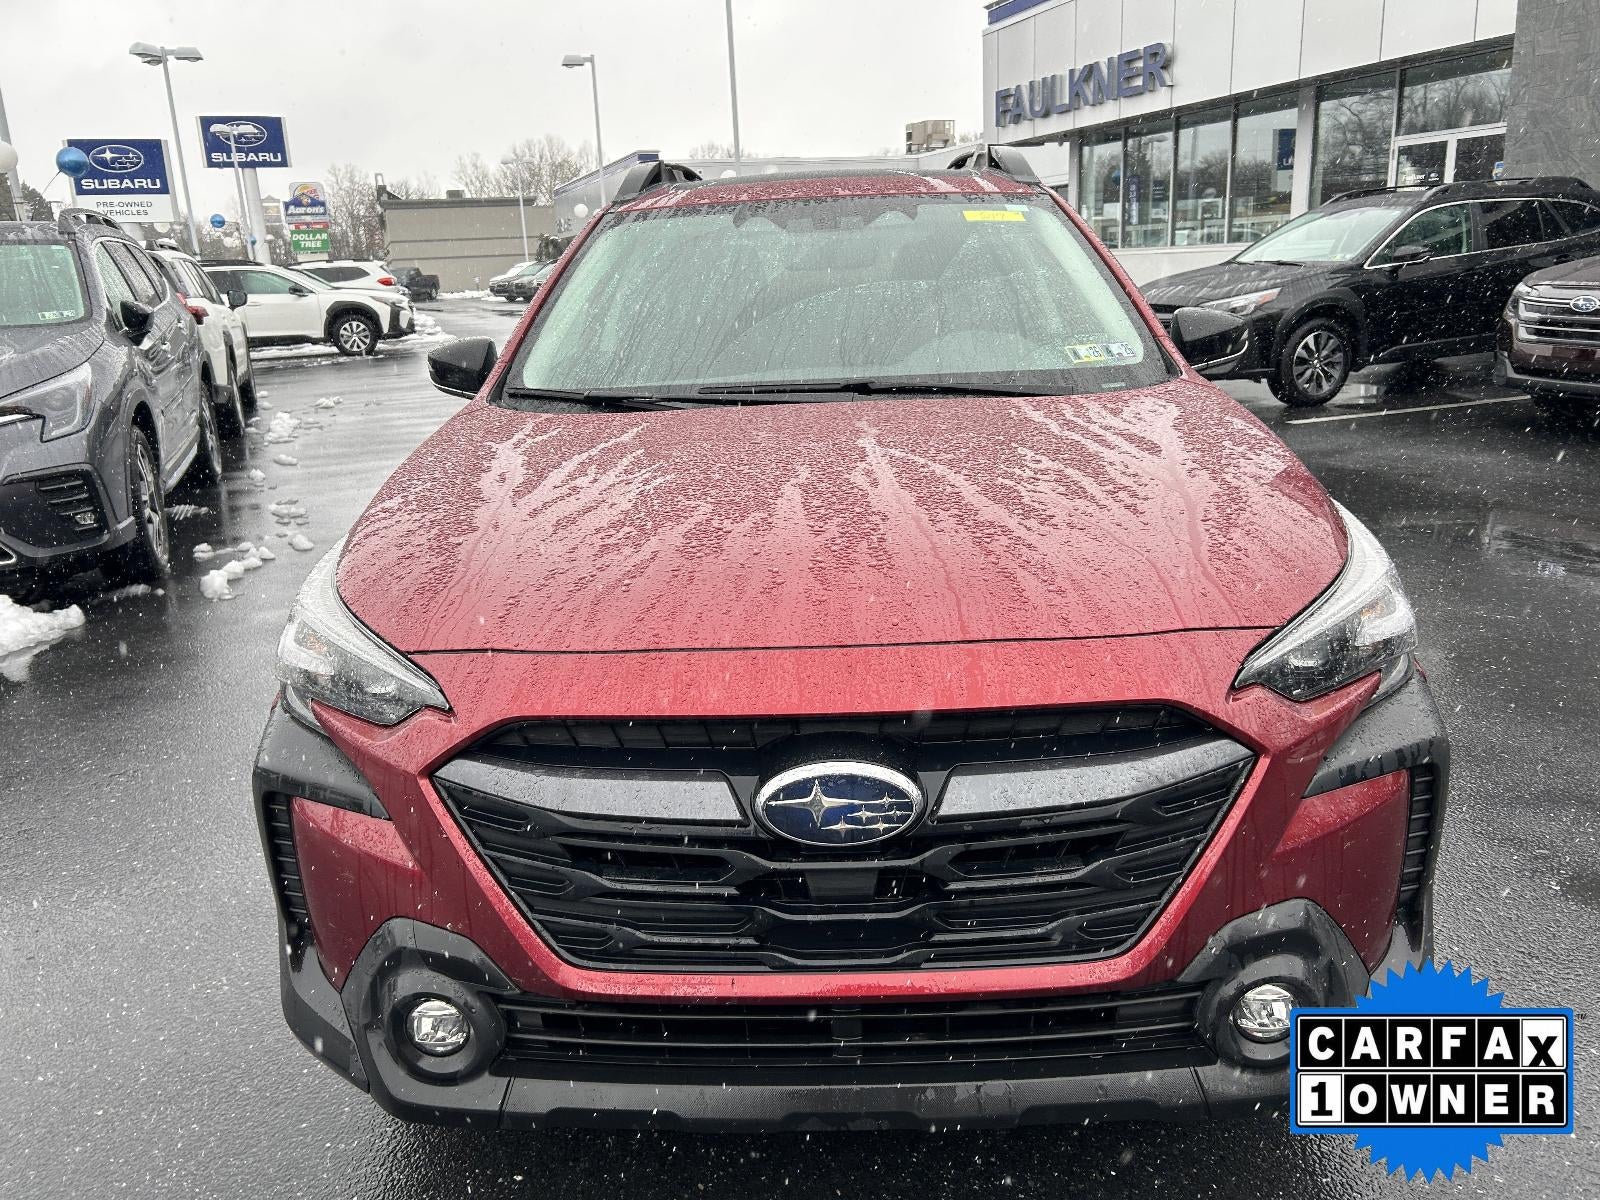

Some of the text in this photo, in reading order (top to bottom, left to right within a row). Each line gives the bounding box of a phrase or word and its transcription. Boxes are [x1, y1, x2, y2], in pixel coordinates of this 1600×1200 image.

[995, 42, 1173, 127] FAULKNER
[211, 152, 282, 162] SUBARU
[81, 178, 160, 189] SUBARU
